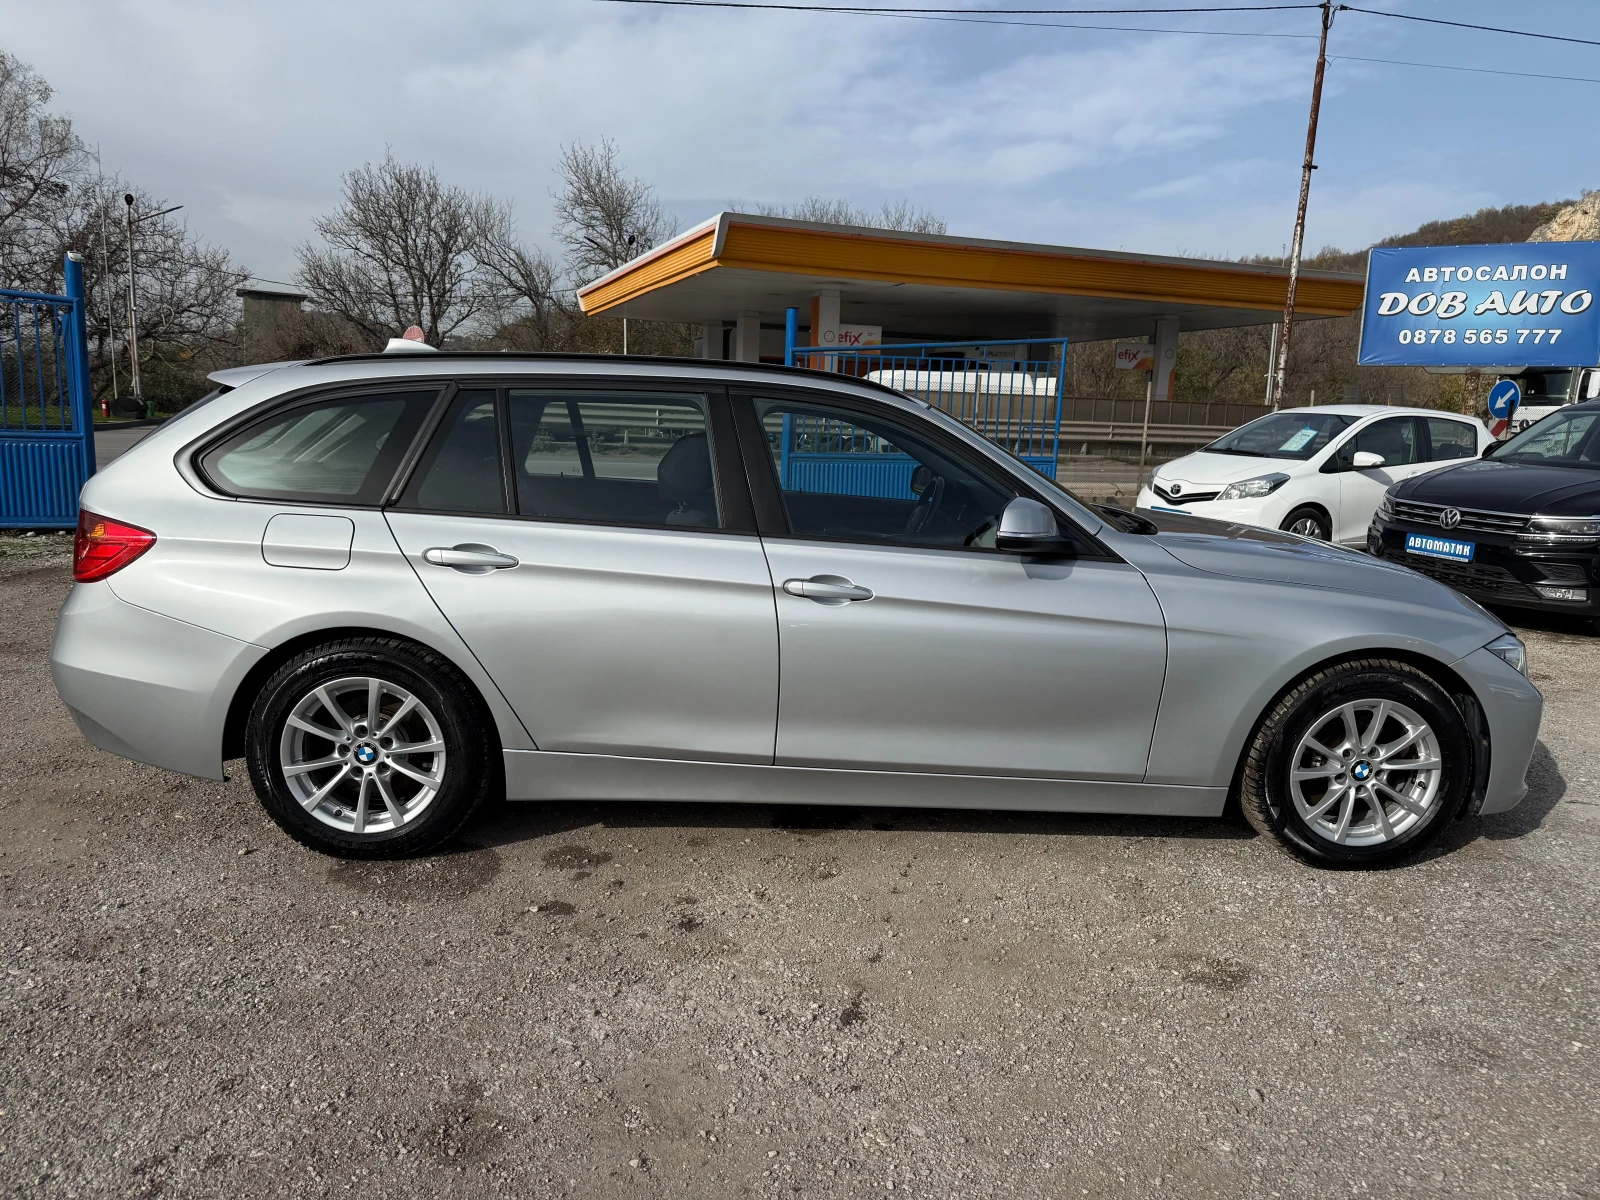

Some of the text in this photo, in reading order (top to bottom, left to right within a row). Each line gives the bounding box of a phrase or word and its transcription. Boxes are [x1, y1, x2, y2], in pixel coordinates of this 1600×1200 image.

[1404, 264, 1568, 283] АВТОСАЛОН
[1473, 289, 1593, 316] AUTO
[838, 331, 864, 346] efix
[1398, 329, 1563, 345] 0878 565 777
[1118, 349, 1140, 362] efix
[1408, 536, 1471, 556] АВТОМАТИК
